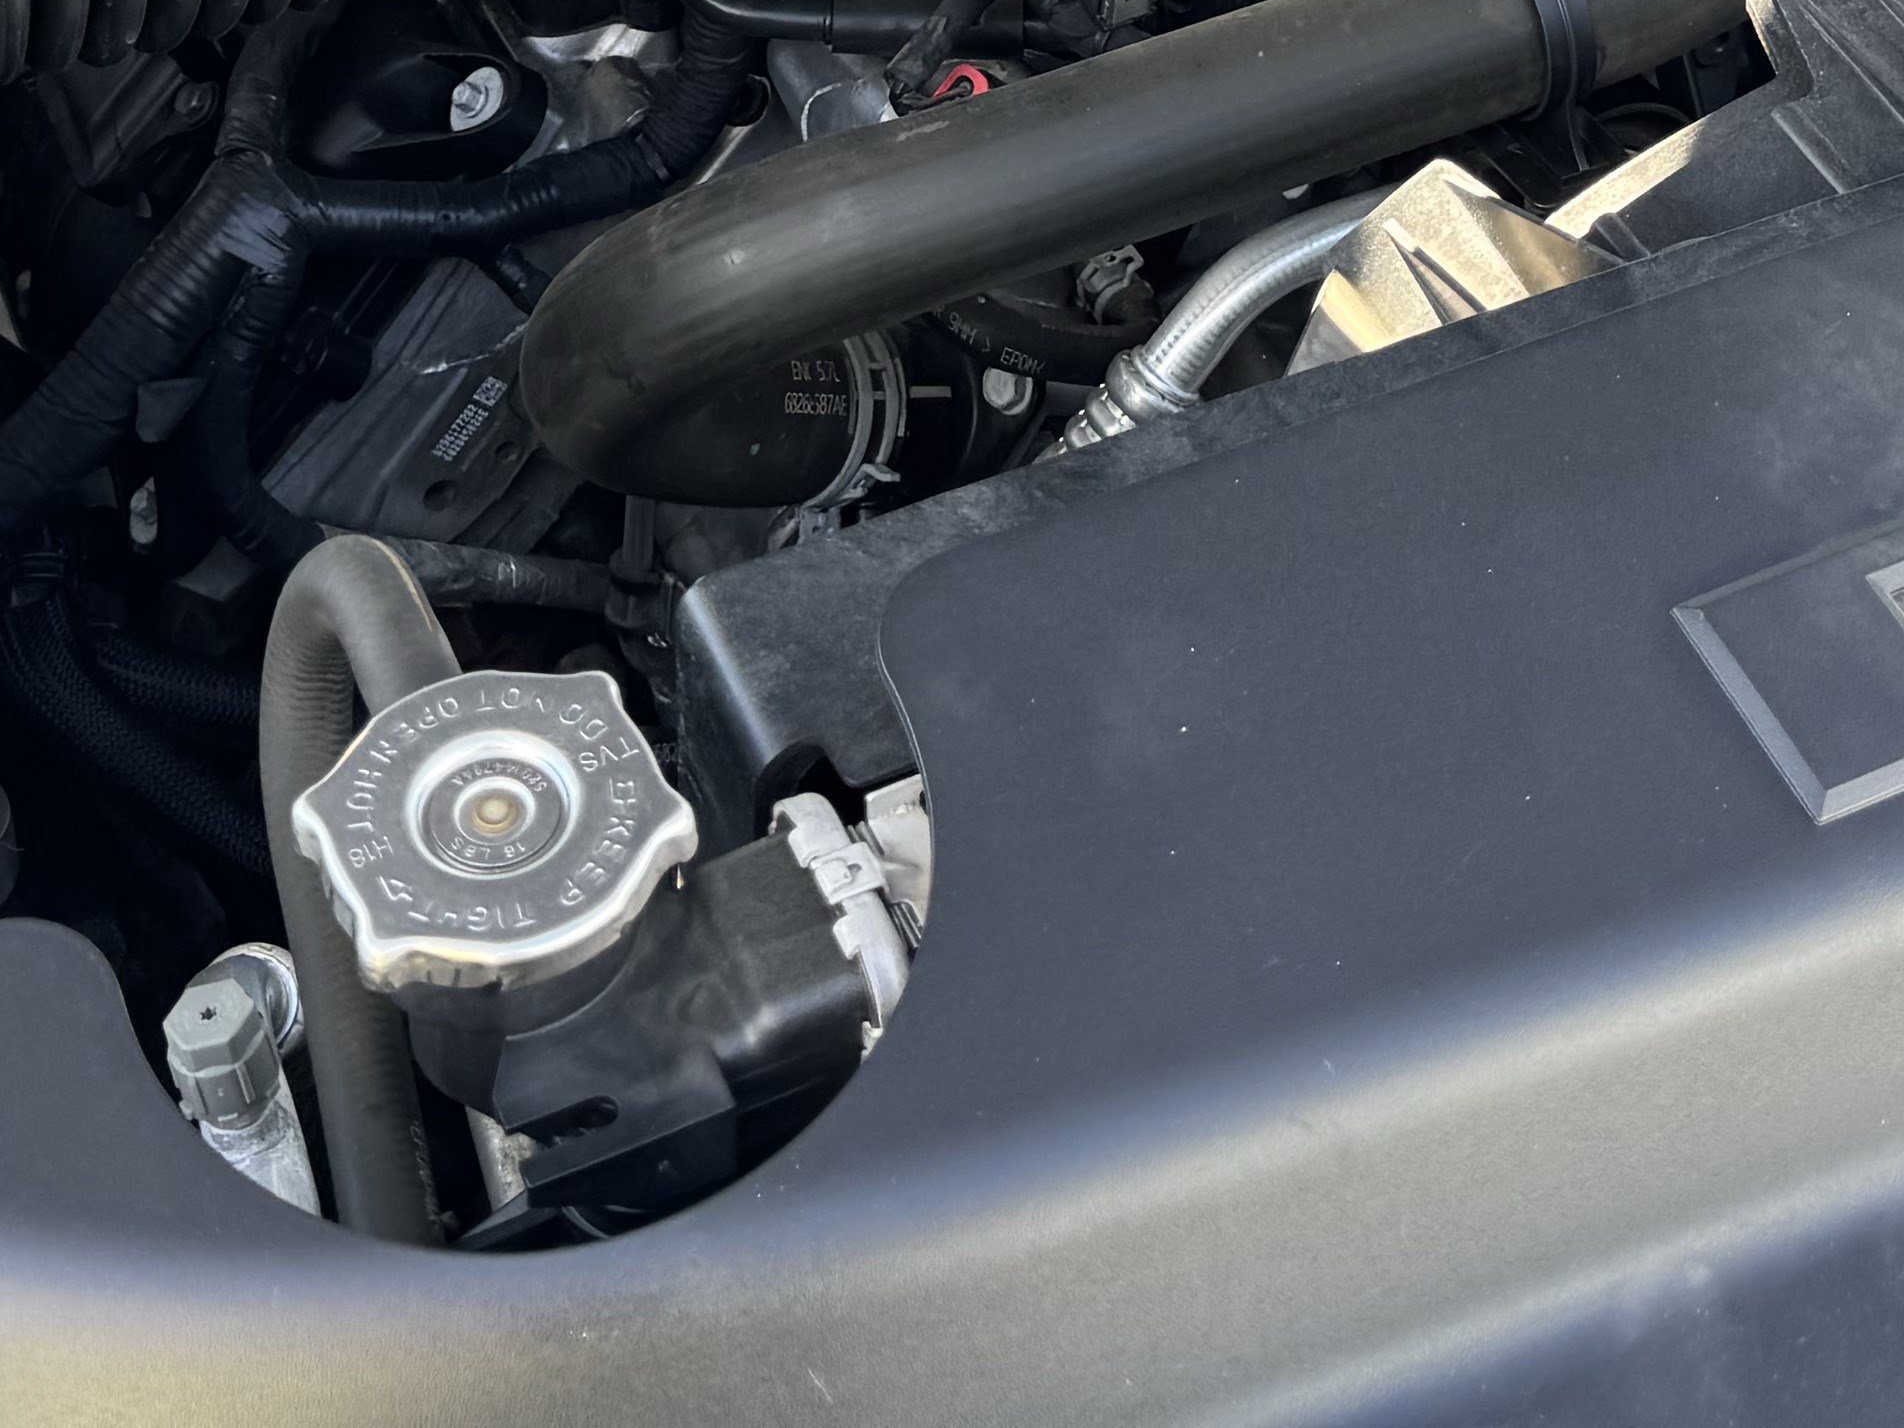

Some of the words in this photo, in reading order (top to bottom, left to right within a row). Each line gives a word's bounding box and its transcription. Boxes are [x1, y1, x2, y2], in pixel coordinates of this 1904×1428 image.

[476, 687, 546, 714] NOT
[369, 697, 463, 764] OPEN
[559, 702, 609, 742] DO
[578, 736, 641, 773] TVS
[346, 768, 384, 833] HOT
[450, 835, 492, 860] LBS
[558, 816, 637, 906] KEEP
[407, 901, 538, 932] TIGHT
